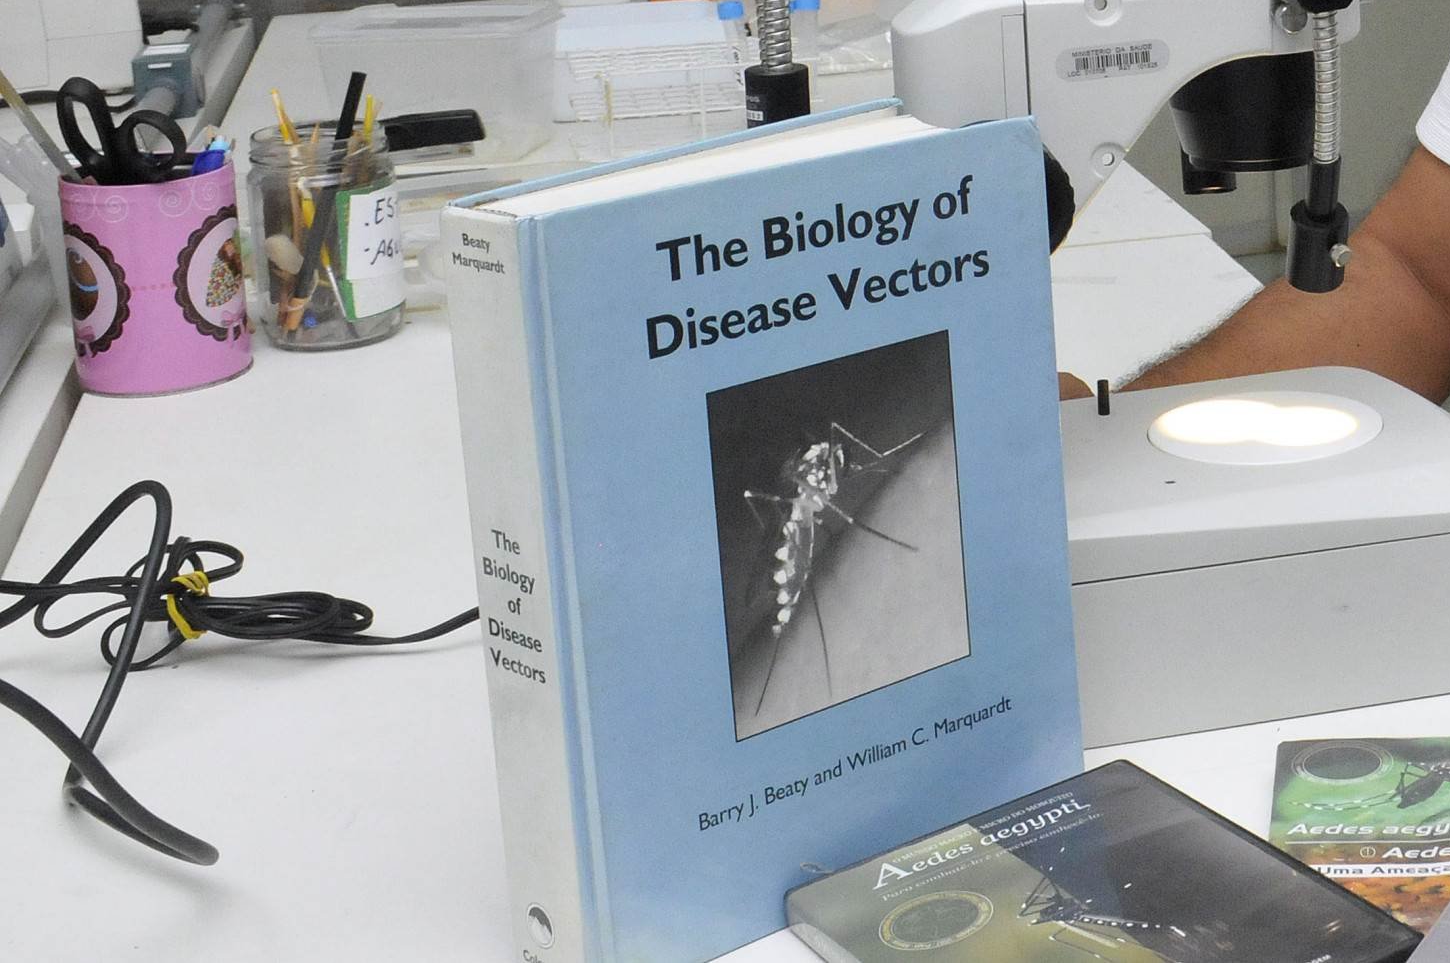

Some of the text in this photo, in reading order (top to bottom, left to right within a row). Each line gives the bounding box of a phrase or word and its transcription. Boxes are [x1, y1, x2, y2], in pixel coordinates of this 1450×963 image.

[462, 233, 490, 254] Beaty
[655, 174, 973, 282] The Biology of
[452, 252, 505, 274] Marquardt
[646, 250, 990, 360] Disease Vectors
[491, 529, 520, 555] The
[482, 556, 535, 595] Biology
[507, 597, 521, 615] of
[488, 617, 542, 653] Disease
[490, 646, 546, 684] Vectors
[698, 696, 1013, 831] Barry J. Beaty and William C. Marquardt
[872, 799, 1092, 889] Aedes aegypti
[1287, 823, 1374, 836] Aedes
[1318, 866, 1363, 875] Uma
